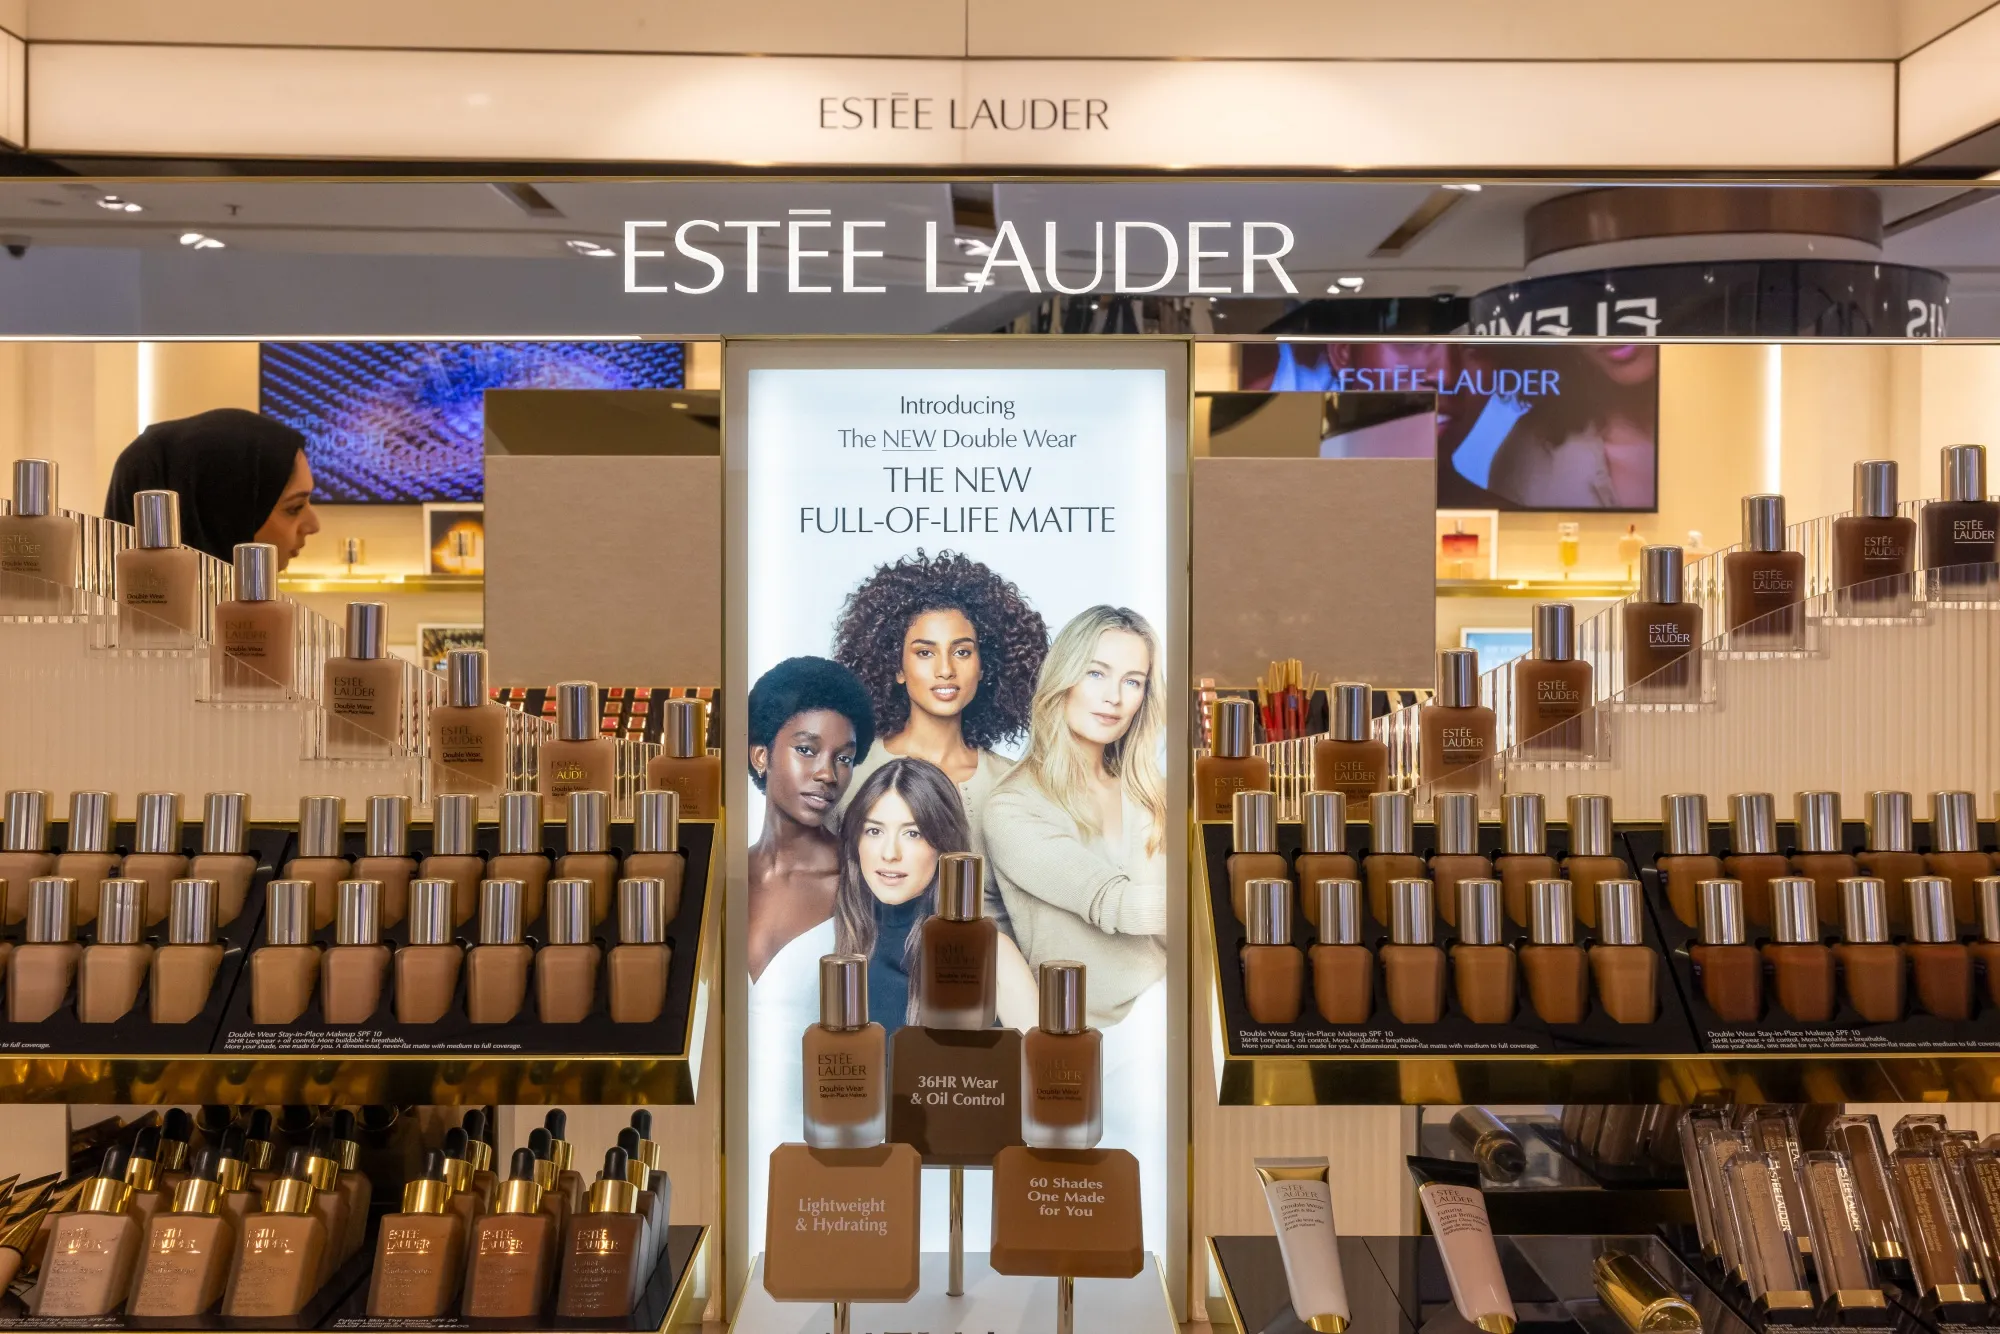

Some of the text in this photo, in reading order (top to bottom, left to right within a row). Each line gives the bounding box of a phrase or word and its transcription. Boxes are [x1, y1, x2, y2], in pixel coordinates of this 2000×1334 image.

[949, 98, 1109, 131] LAUDER
[925, 220, 1300, 295] LAUDER
[1438, 368, 1561, 396] LAUDER
[900, 394, 1015, 420] Introducing
[838, 428, 1077, 449] The NEW Double Wear
[883, 466, 1032, 493] THE NEW
[799, 506, 1116, 534] FULL-OF-LIFE MATTE
[1954, 530, 1996, 540] LAUDER
[1753, 580, 1794, 590] LAUDER
[1649, 633, 1691, 643] LAUDER
[334, 687, 375, 697] LAUDER
[1537, 690, 1580, 700] LAUDER
[1442, 738, 1484, 748] LAUDER
[1334, 771, 1376, 781] LAUDER
[278, 1031, 324, 1039] Stay-in-Place
[326, 1031, 355, 1039] Makeup
[1290, 1030, 1336, 1038] Stay-in-Place
[818, 1065, 867, 1076] LAUDER
[918, 1075, 998, 1089] 36HR Wear
[819, 1085, 845, 1093] Double
[910, 1092, 1005, 1106] & Oil Control
[1029, 1177, 1103, 1190] 60 Shades
[1027, 1190, 1105, 1203] One Made
[798, 1197, 886, 1216] Lightweight
[1039, 1204, 1093, 1217] for You
[1775, 1195, 1792, 1232] LAUDER
[1846, 1195, 1862, 1232] LAUDER
[795, 1217, 888, 1236] & Hydrating
